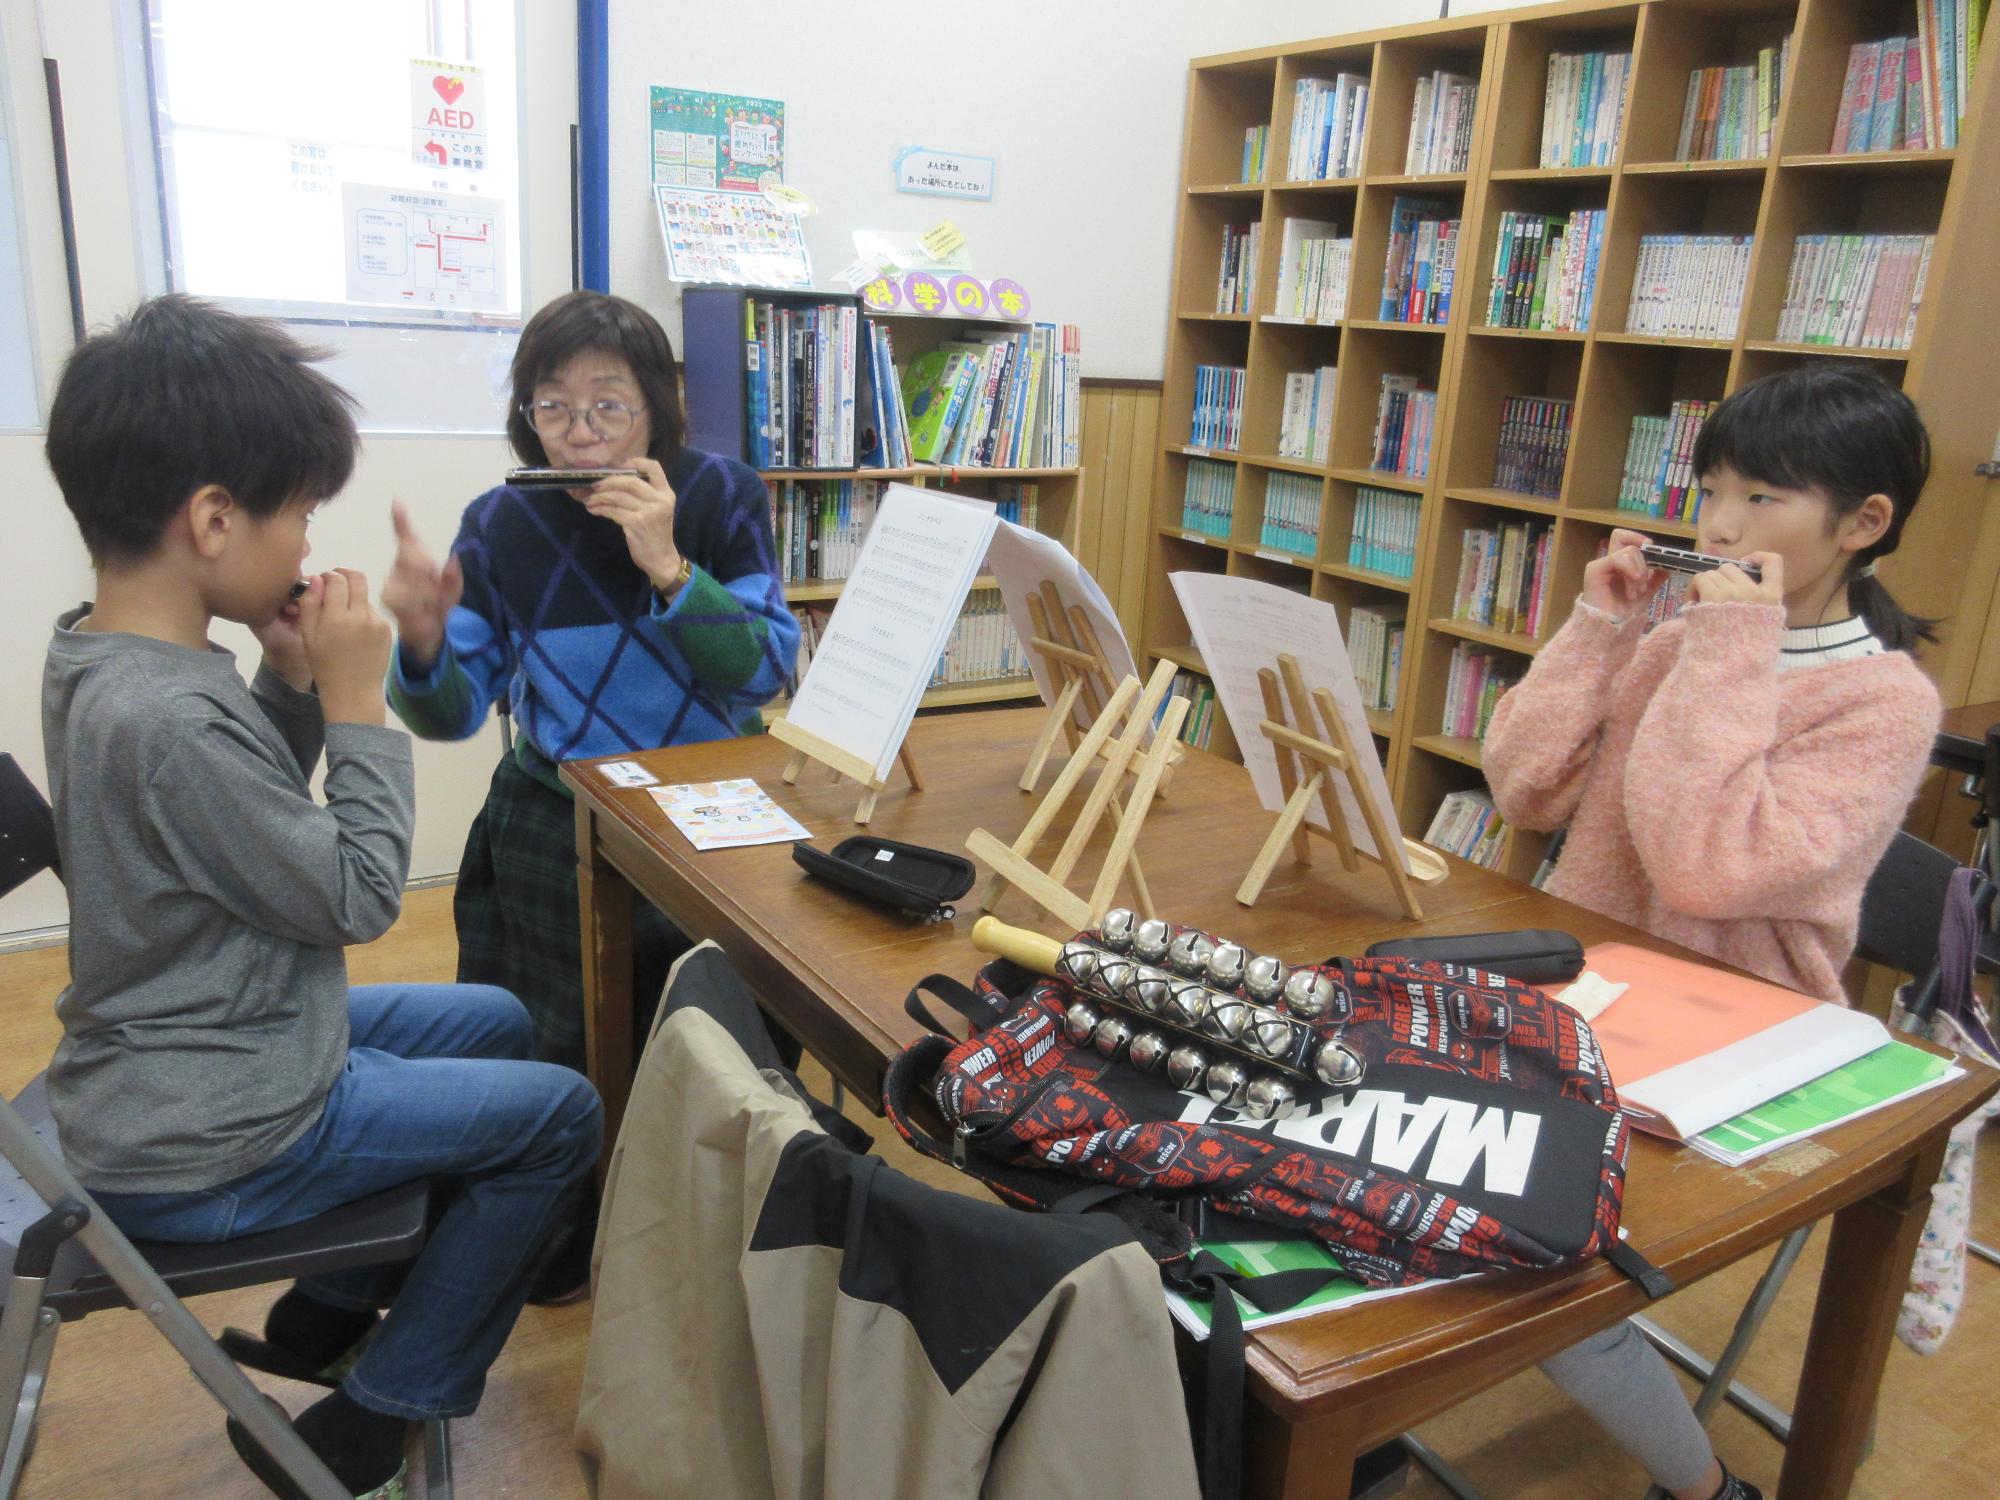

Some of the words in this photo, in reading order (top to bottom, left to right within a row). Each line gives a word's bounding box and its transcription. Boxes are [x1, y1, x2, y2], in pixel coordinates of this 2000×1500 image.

[427, 107, 474, 130] AED
[452, 143, 484, 156] この先
[864, 278, 1025, 315] 科学の本
[1407, 983, 1428, 1048] POWER
[1024, 1030, 1056, 1068] POWER
[1157, 1142, 1177, 1165] RESCUE
[1178, 1090, 1541, 1197] MAR
